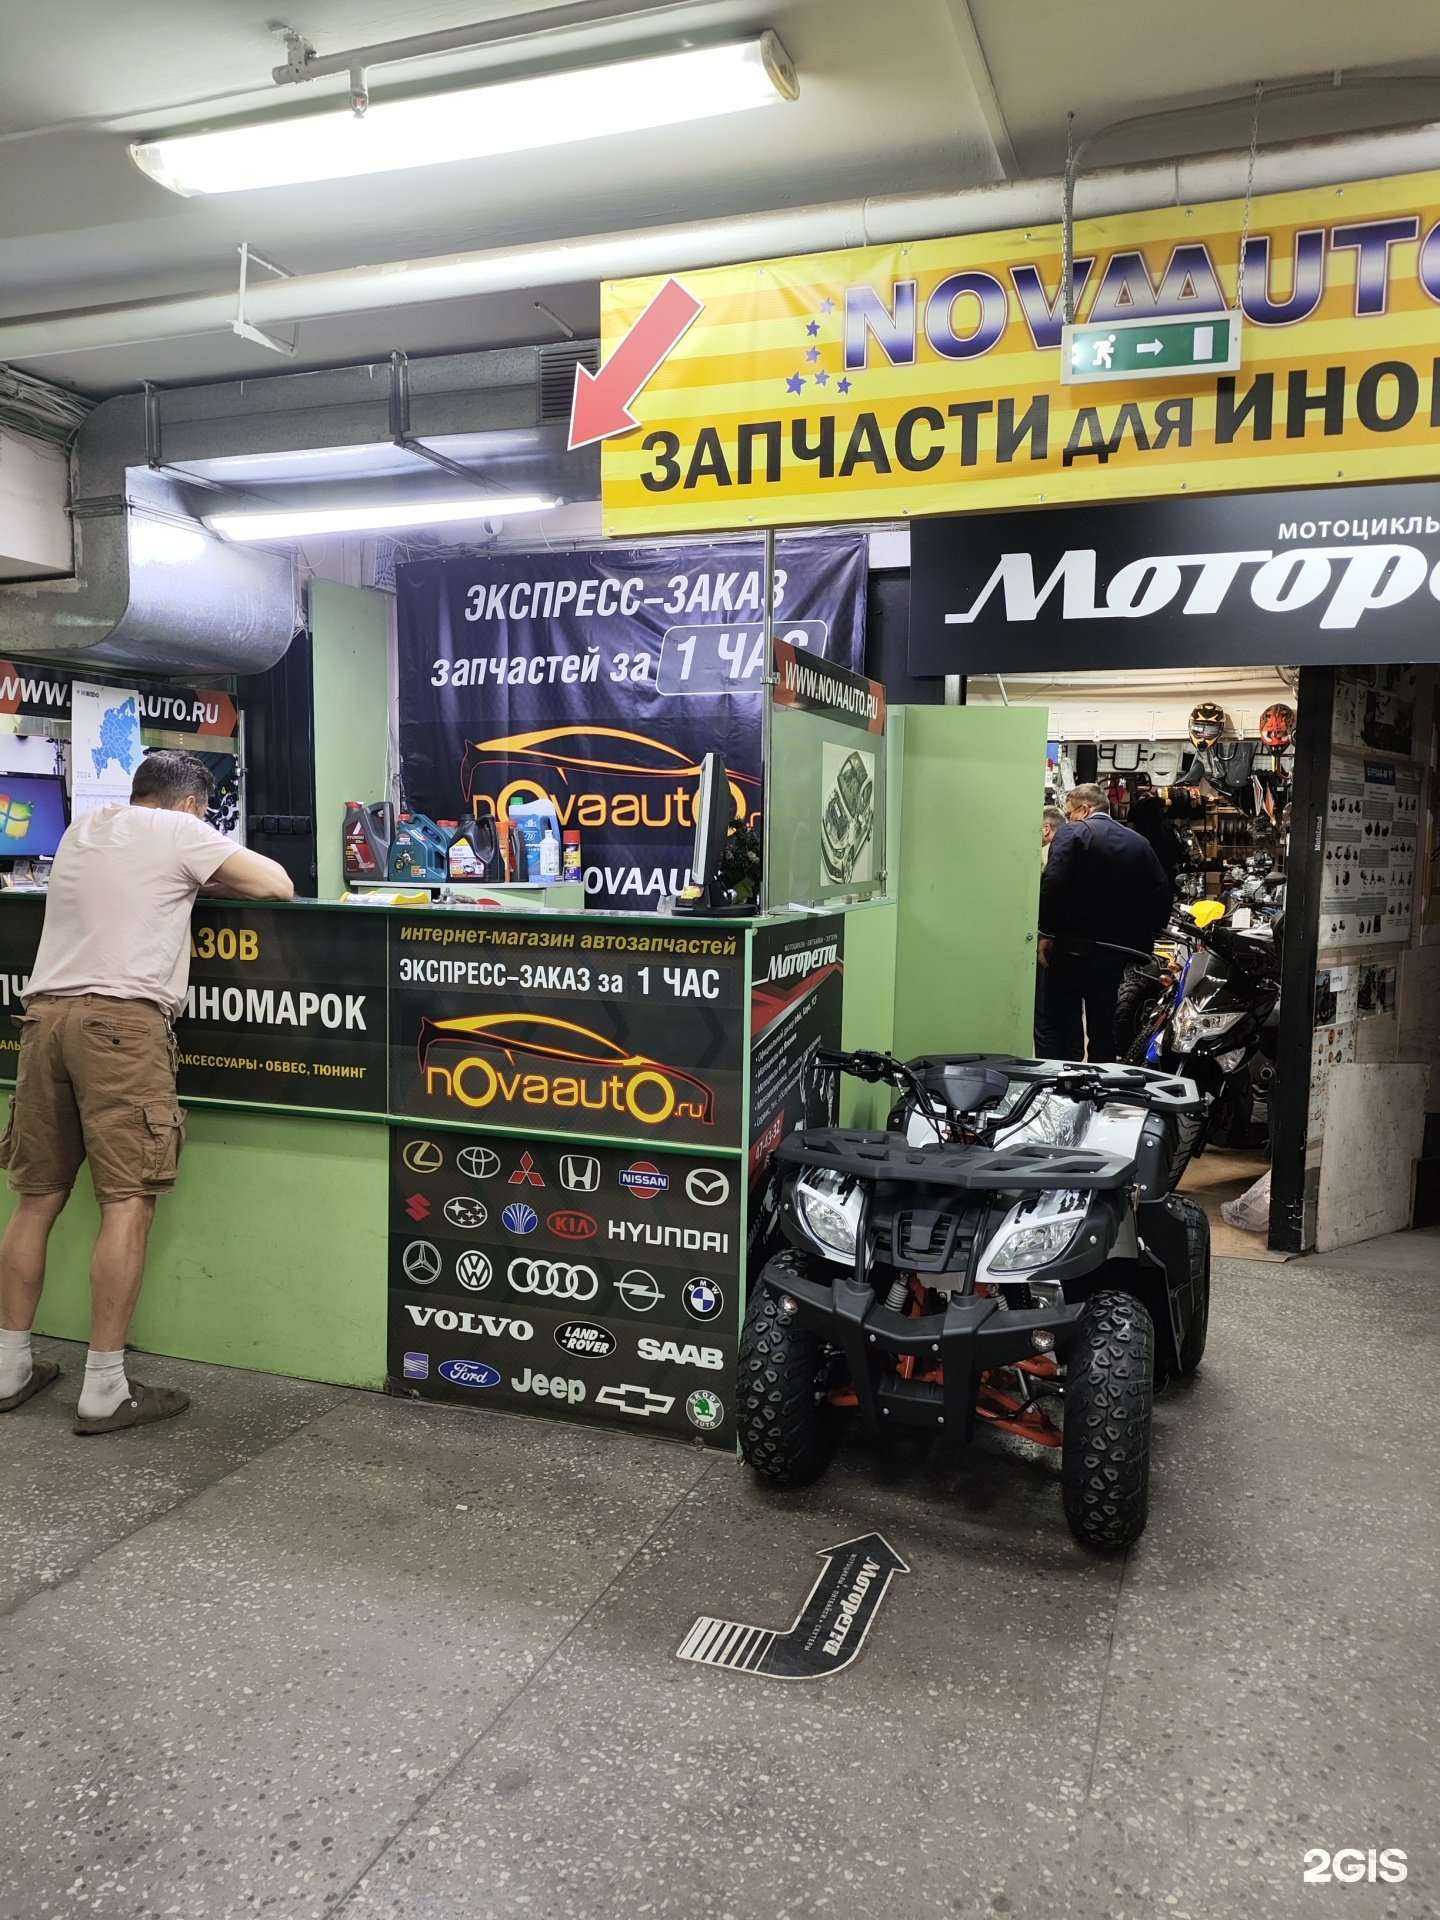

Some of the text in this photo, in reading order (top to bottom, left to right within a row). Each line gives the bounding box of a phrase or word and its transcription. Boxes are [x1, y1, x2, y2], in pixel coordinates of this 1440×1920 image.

[842, 215, 1440, 372] NOVAAUT
[639, 395, 1051, 493] ЗАПЧАСТИ
[1214, 356, 1440, 445] ИНО
[943, 543, 1440, 630] Мотор
[430, 629, 809, 688] запчастей за 1 ЧА
[785, 660, 879, 720] WWW.NOVAAUTO.RU
[400, 924, 737, 956] интернет-магазин автозапчастей
[598, 972, 624, 994] за
[637, 966, 650, 995] 1
[663, 967, 720, 1000] ЧАС
[265, 1060, 312, 1077] ОБВЕС,
[312, 1063, 367, 1080] ТЮНИНГ
[622, 1173, 668, 1187] NISSAN
[555, 1215, 591, 1235] KIA
[608, 1219, 729, 1254] HYUNDAI
[688, 1279, 720, 1296] BMW
[404, 1304, 535, 1342] VOLVO
[637, 1337, 725, 1371] SAAB
[449, 1362, 489, 1385] Ford
[511, 1367, 587, 1405] Jeep
[694, 1419, 716, 1428] AUTO
